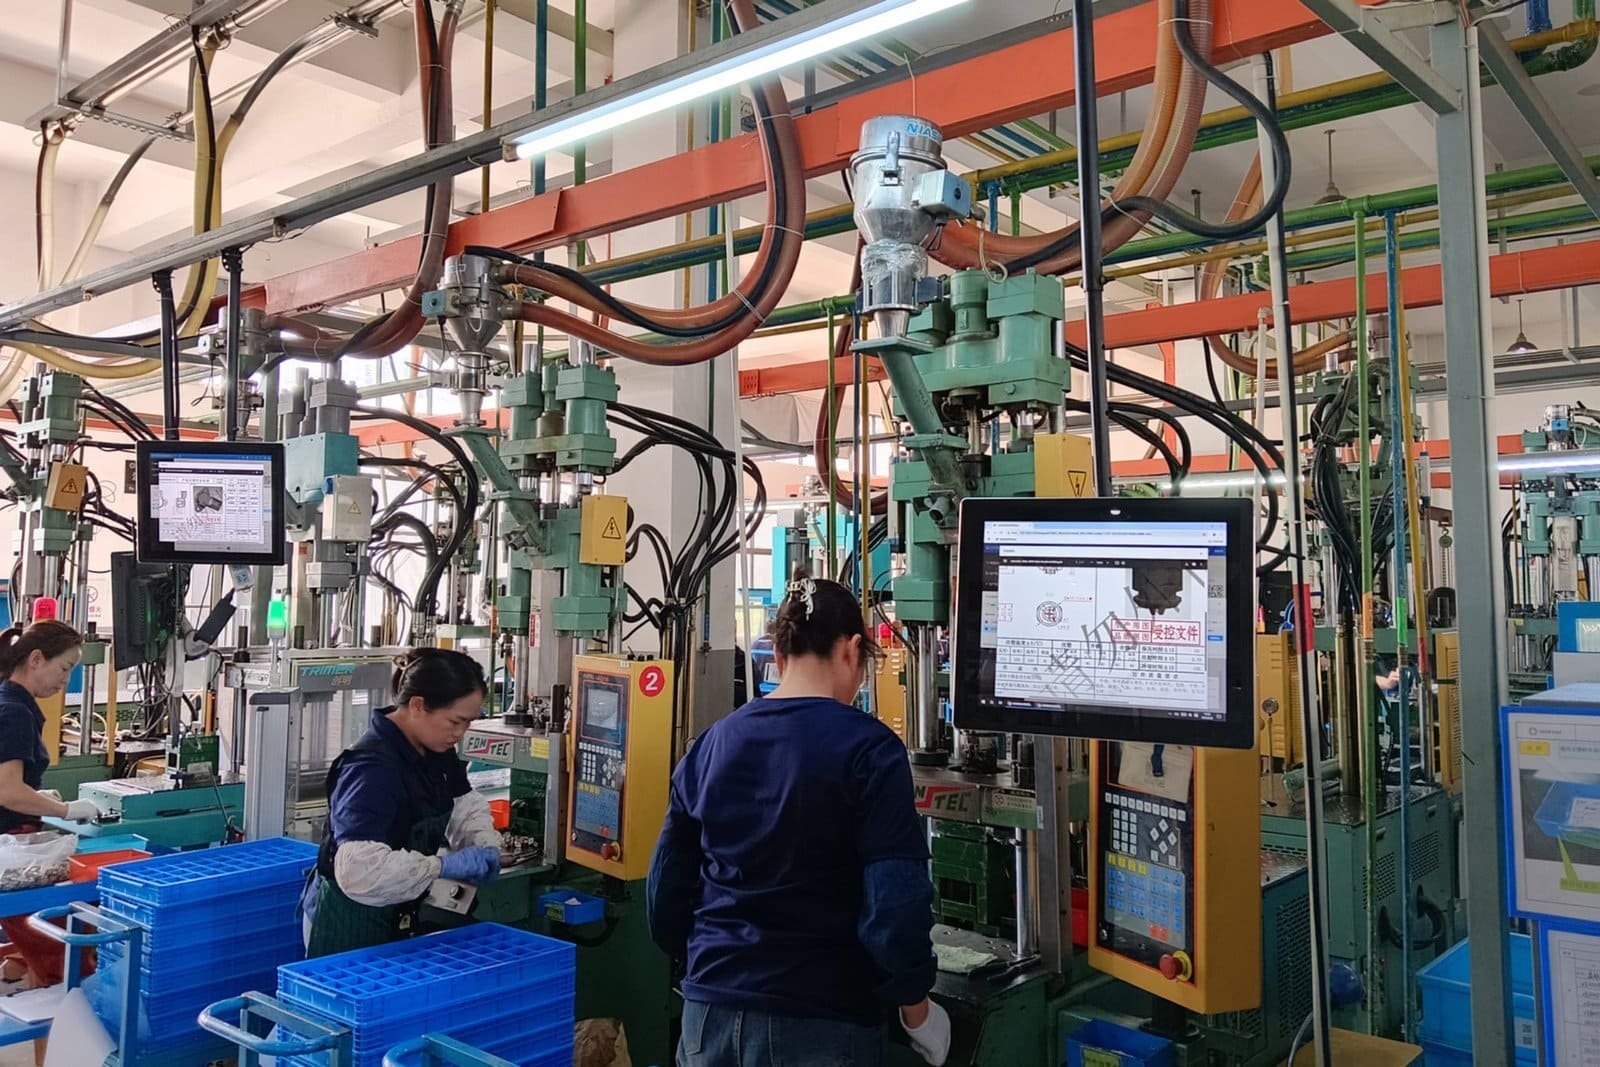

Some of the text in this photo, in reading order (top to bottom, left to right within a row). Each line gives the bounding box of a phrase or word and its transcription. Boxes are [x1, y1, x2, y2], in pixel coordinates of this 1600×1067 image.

[1152, 624, 1198, 640] 受控文件
[645, 672, 658, 691] 2
